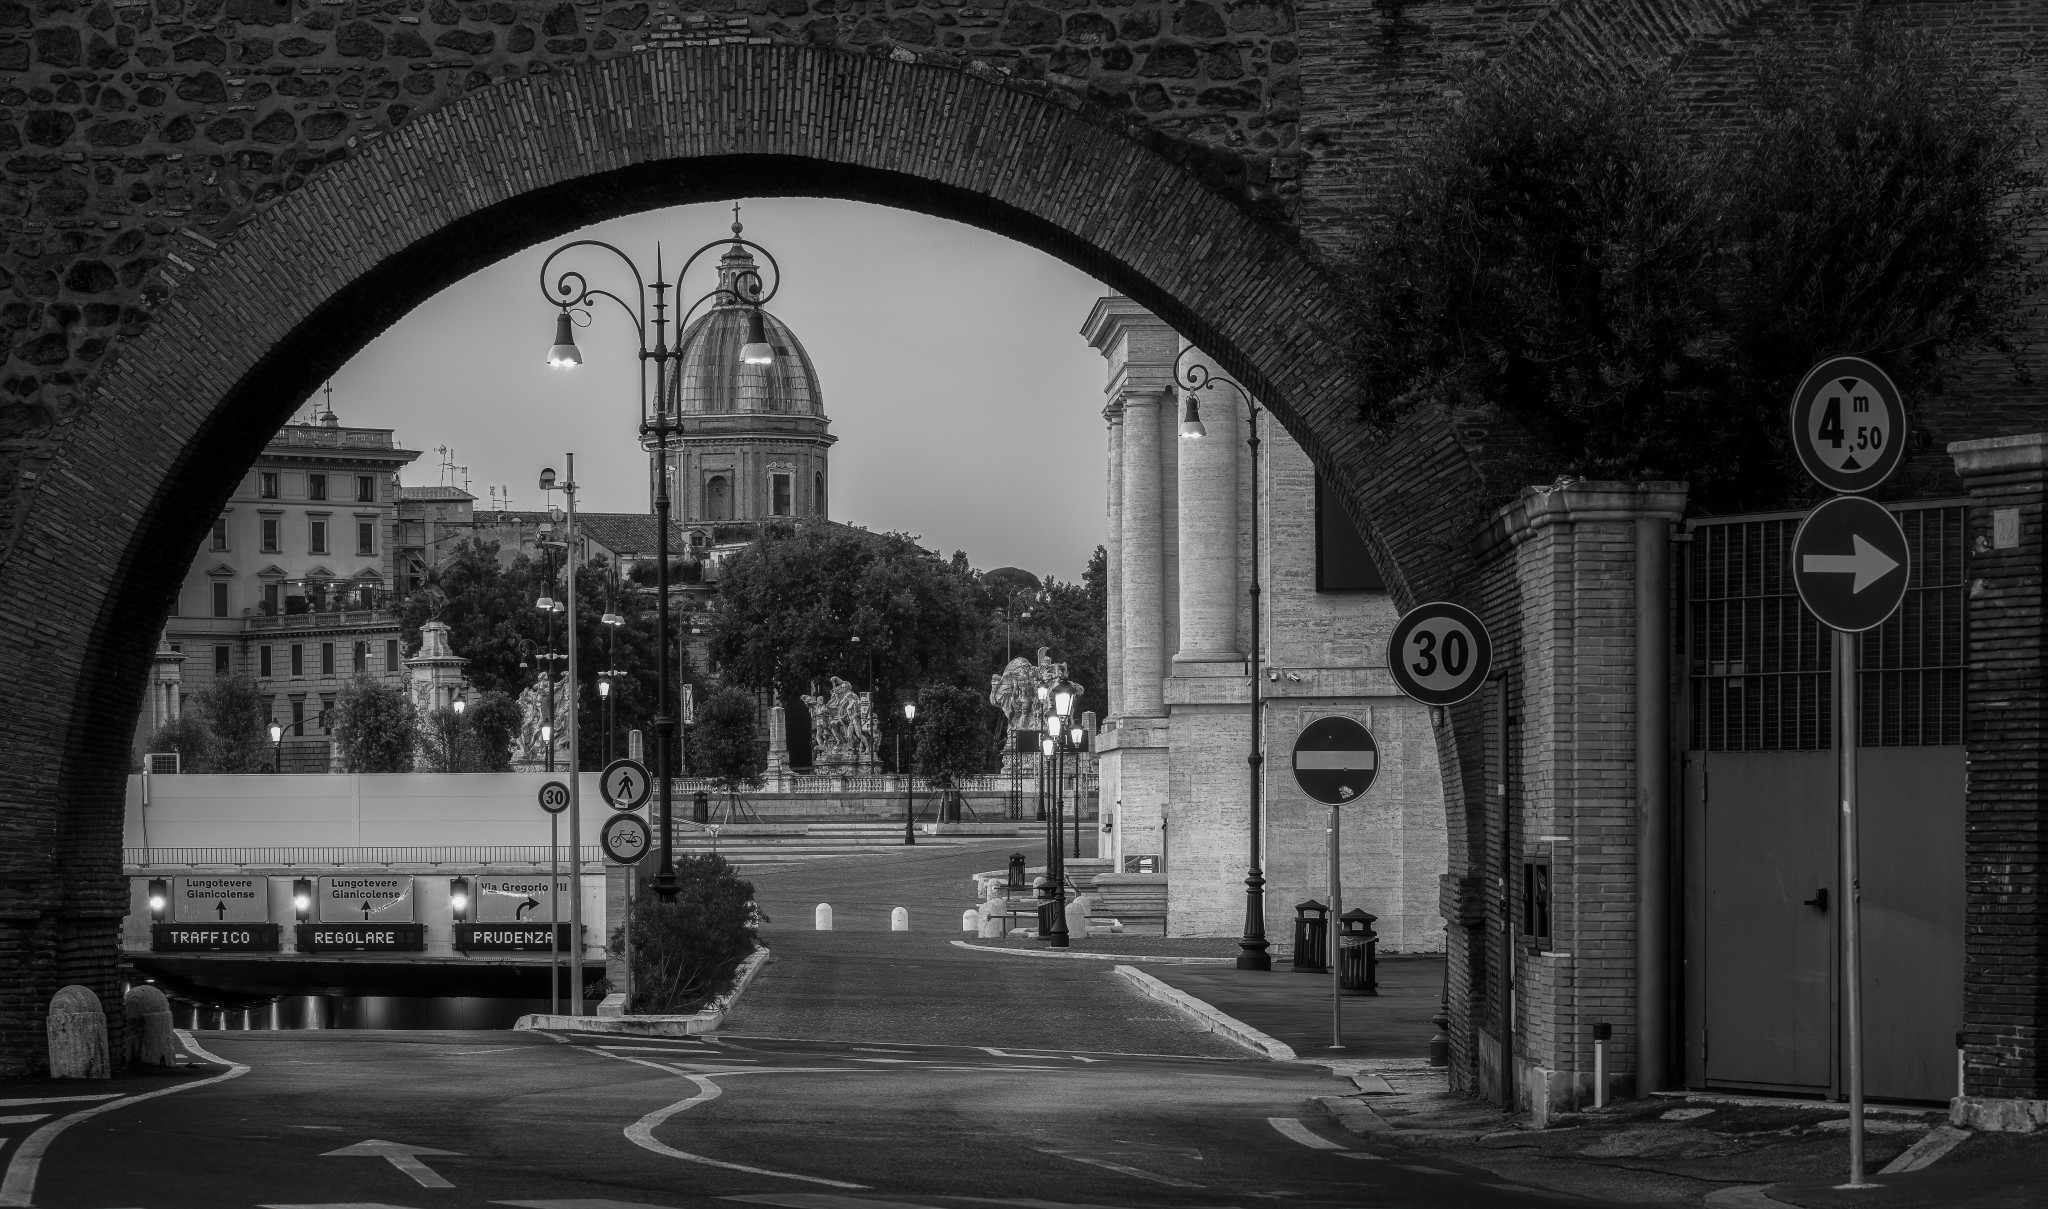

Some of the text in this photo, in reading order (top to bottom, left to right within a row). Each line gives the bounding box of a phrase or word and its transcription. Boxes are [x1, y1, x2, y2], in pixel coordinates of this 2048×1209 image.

[1412, 629, 1469, 677] 30
[545, 790, 564, 805] 30
[186, 878, 253, 889] Lungotevere
[331, 878, 398, 889] Lungotevere
[481, 882, 497, 892] Via
[501, 882, 549, 893] Gregorio
[187, 889, 255, 899] Gianicolense
[332, 889, 400, 899] Gianicolense
[170, 931, 250, 944] TRAFFICO
[314, 931, 395, 944] REGOLARE
[473, 931, 553, 944] PRUDENZA
